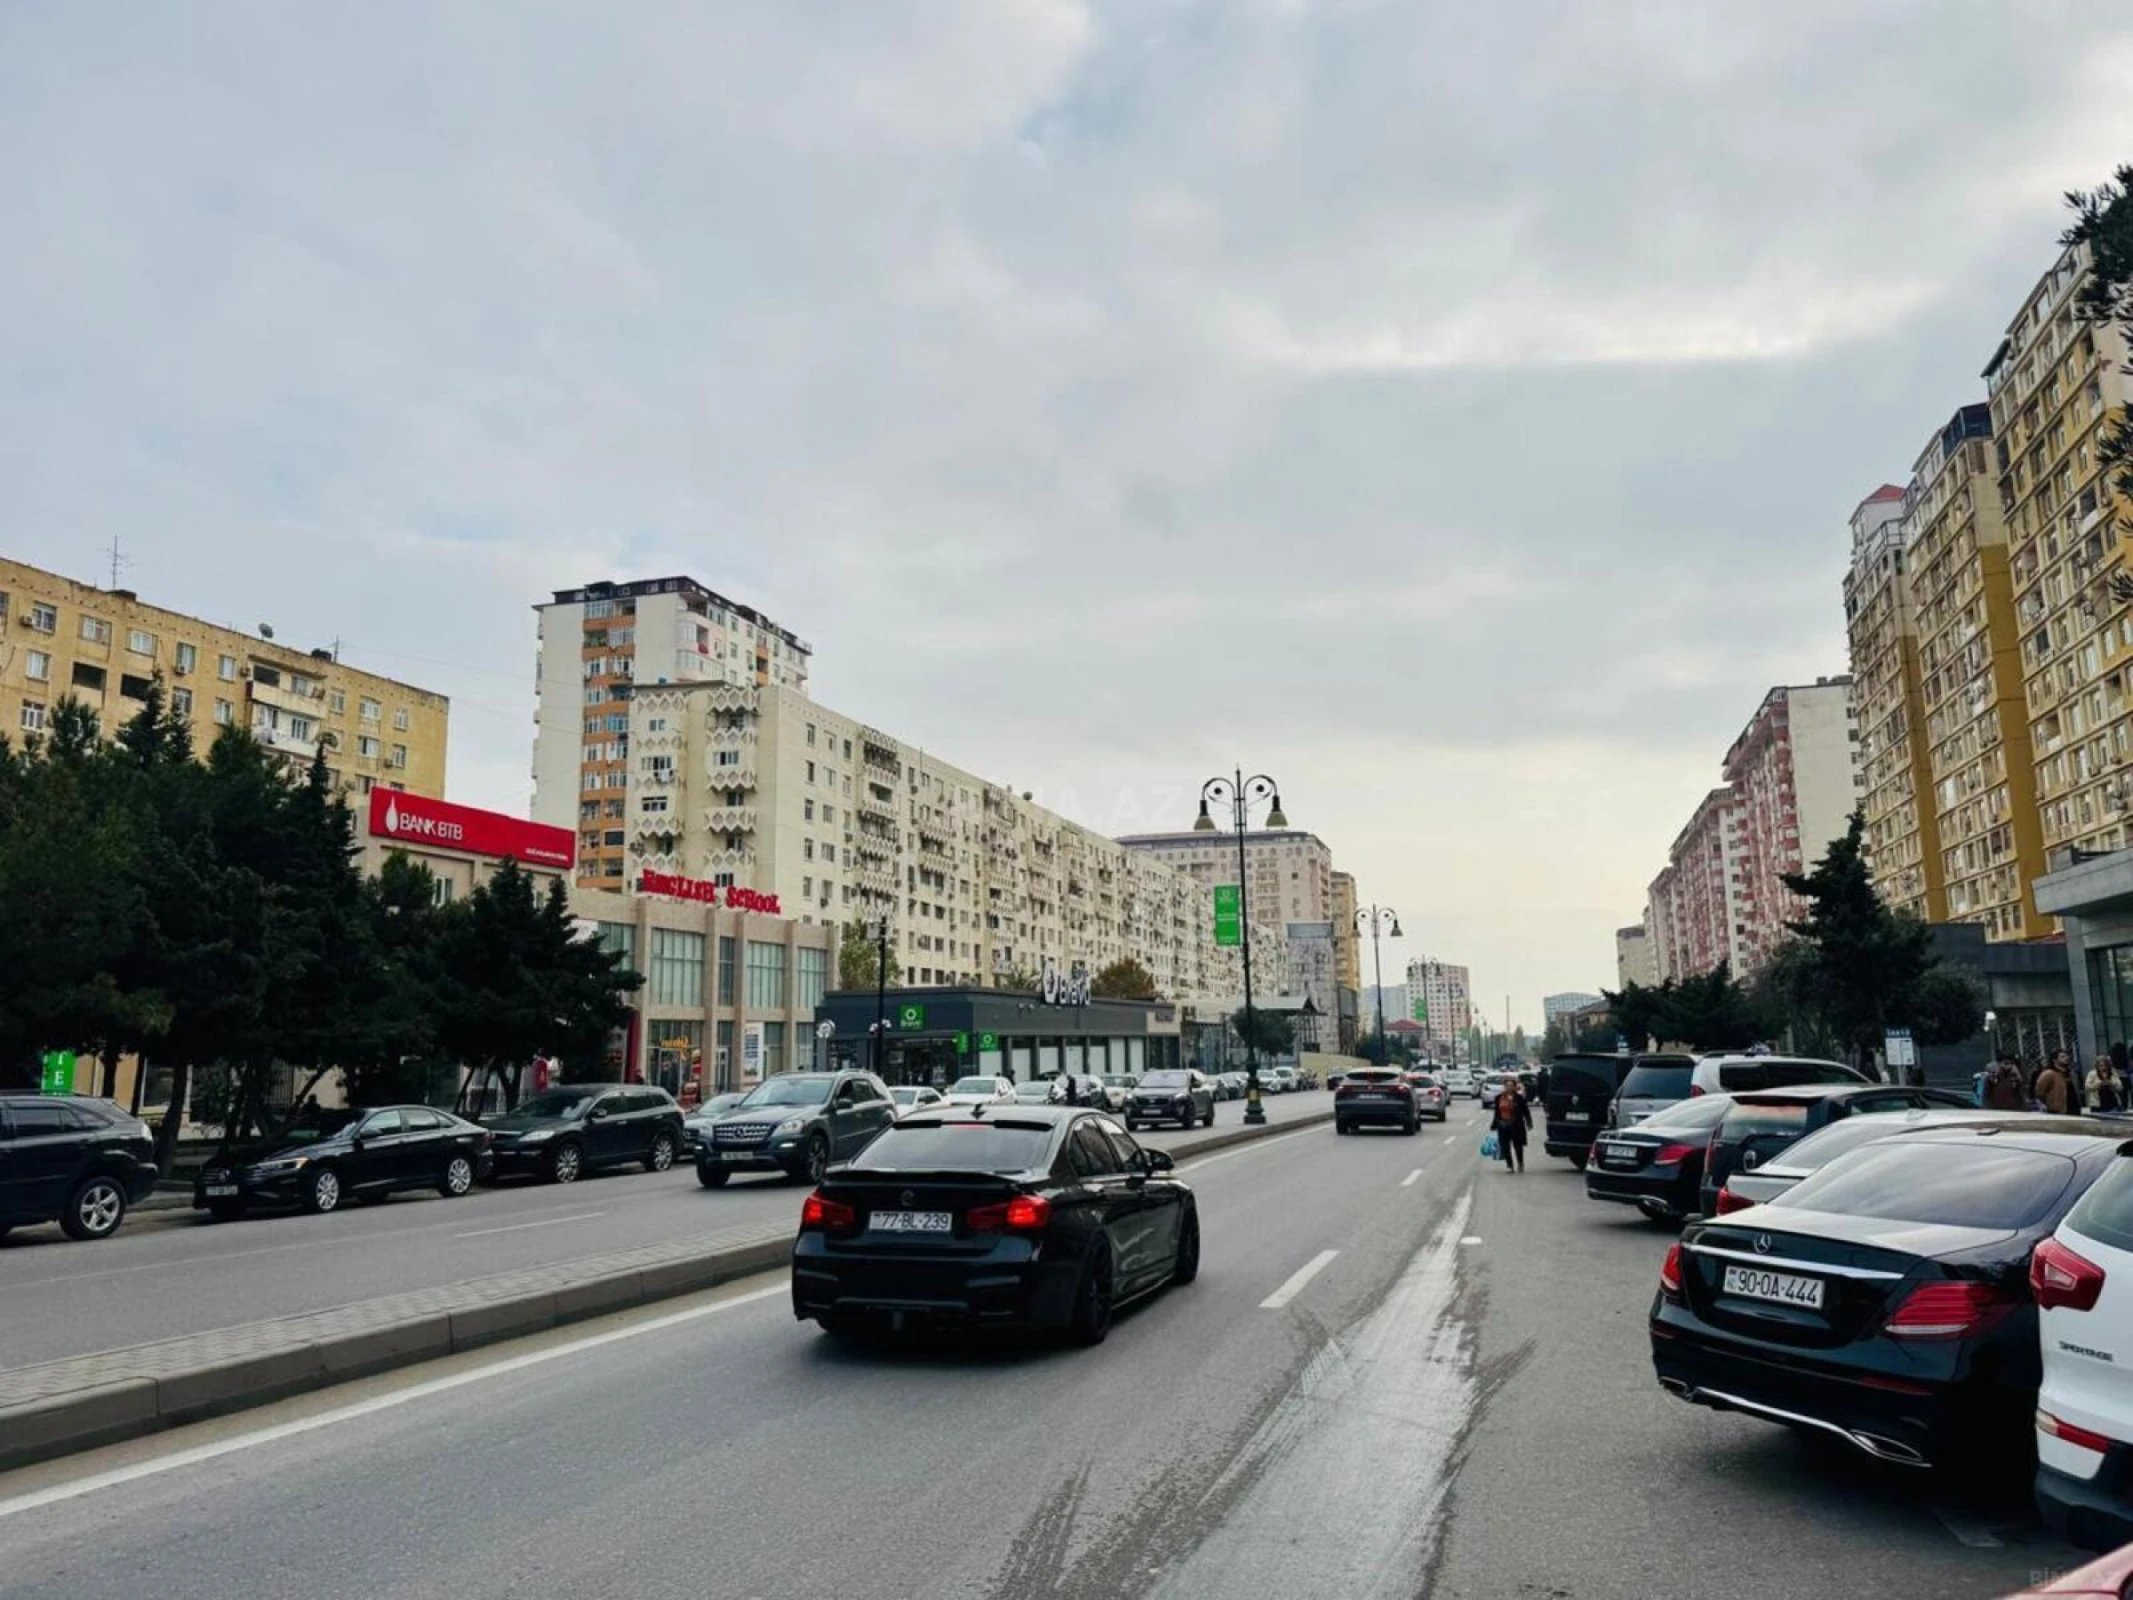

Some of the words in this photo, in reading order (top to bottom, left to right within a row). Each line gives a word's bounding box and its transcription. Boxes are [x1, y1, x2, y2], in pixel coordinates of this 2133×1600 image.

[400, 813, 437, 835] BANK
[438, 823, 463, 841] BTB
[1738, 1270, 1819, 1304] 90-OA-444
